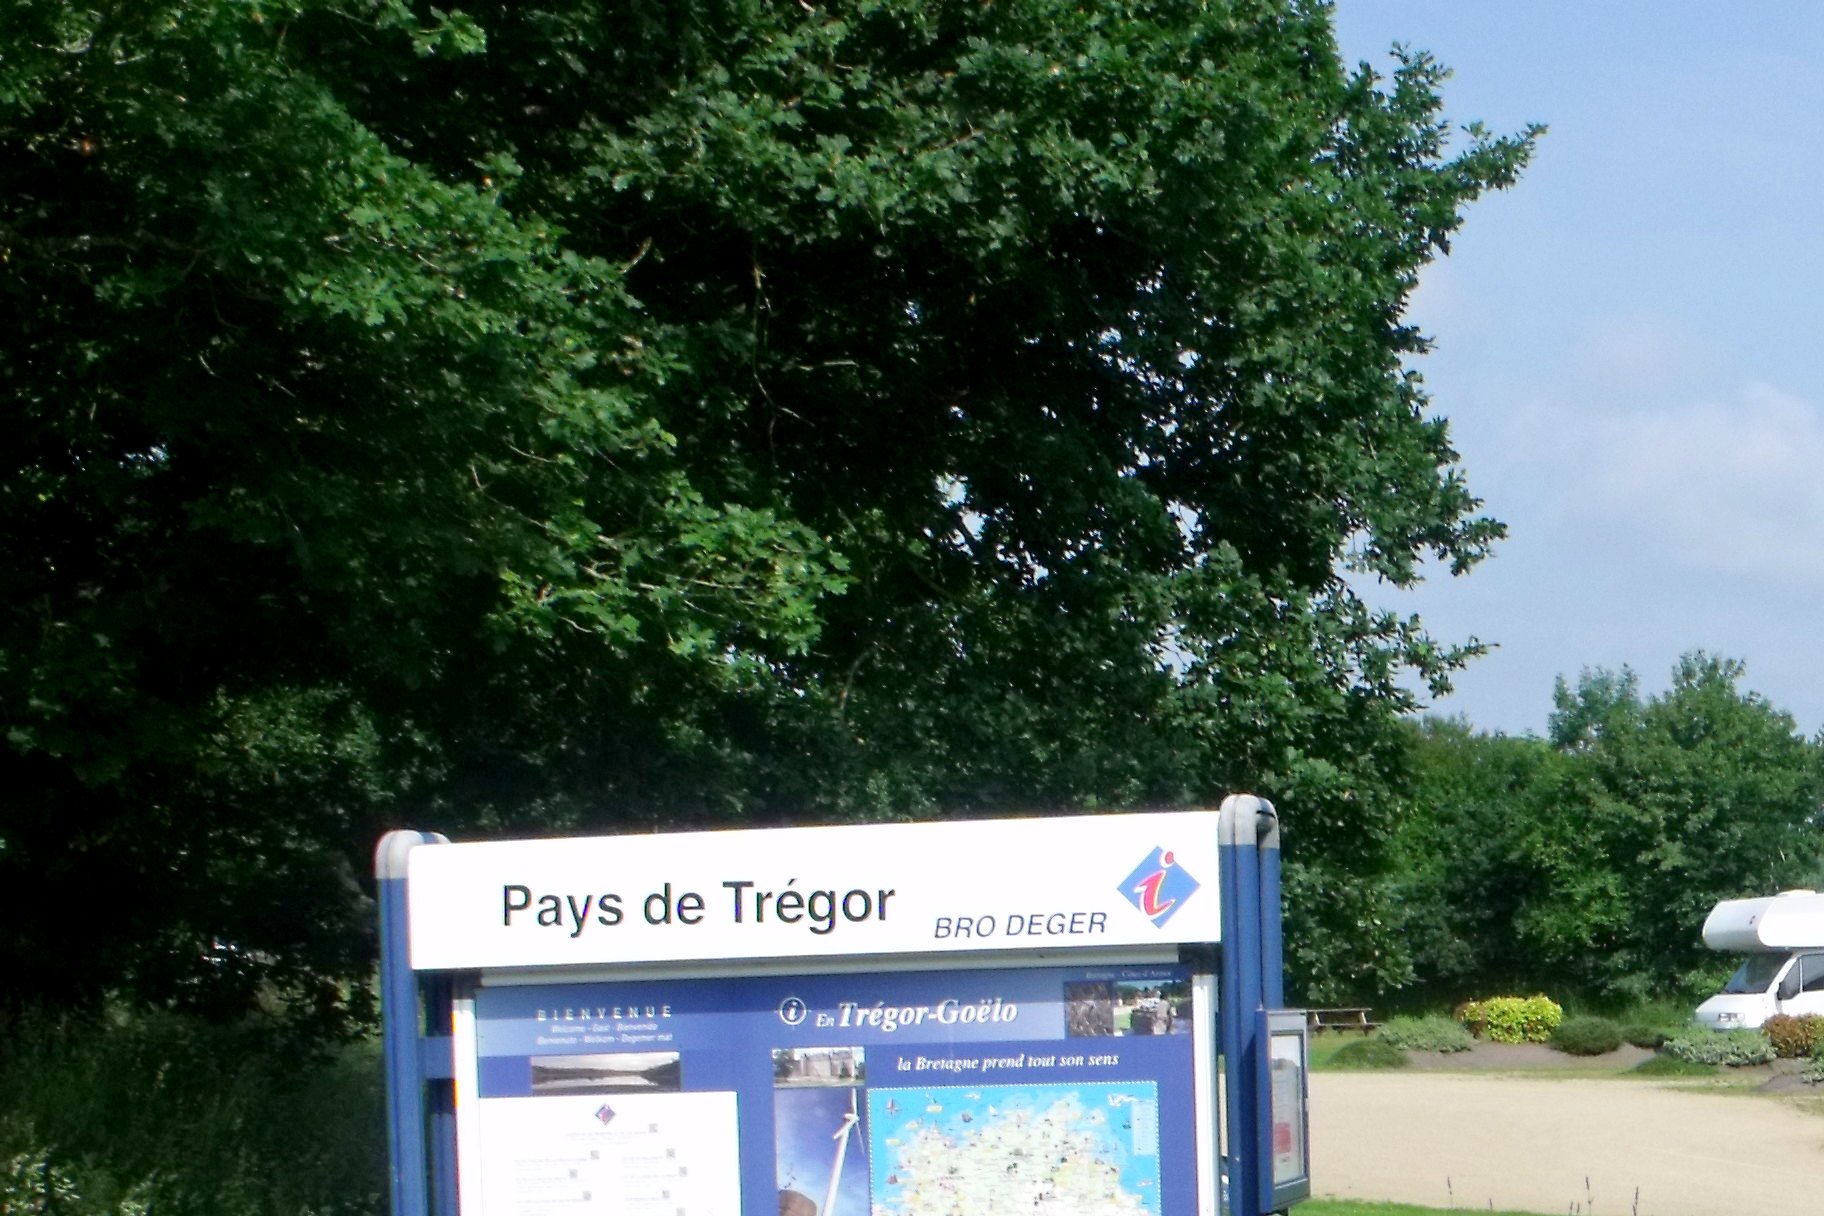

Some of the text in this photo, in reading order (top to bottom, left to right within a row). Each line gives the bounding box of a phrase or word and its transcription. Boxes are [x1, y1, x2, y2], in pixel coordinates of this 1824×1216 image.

[502, 878, 897, 939] Pays de Trégor
[934, 911, 1108, 938] BRO DEGER
[536, 1005, 672, 1021] BIENVENUE
[816, 997, 1019, 1032] En Trégor-Goëlo
[897, 1054, 1119, 1073] la Bretagne prend tout son sens
